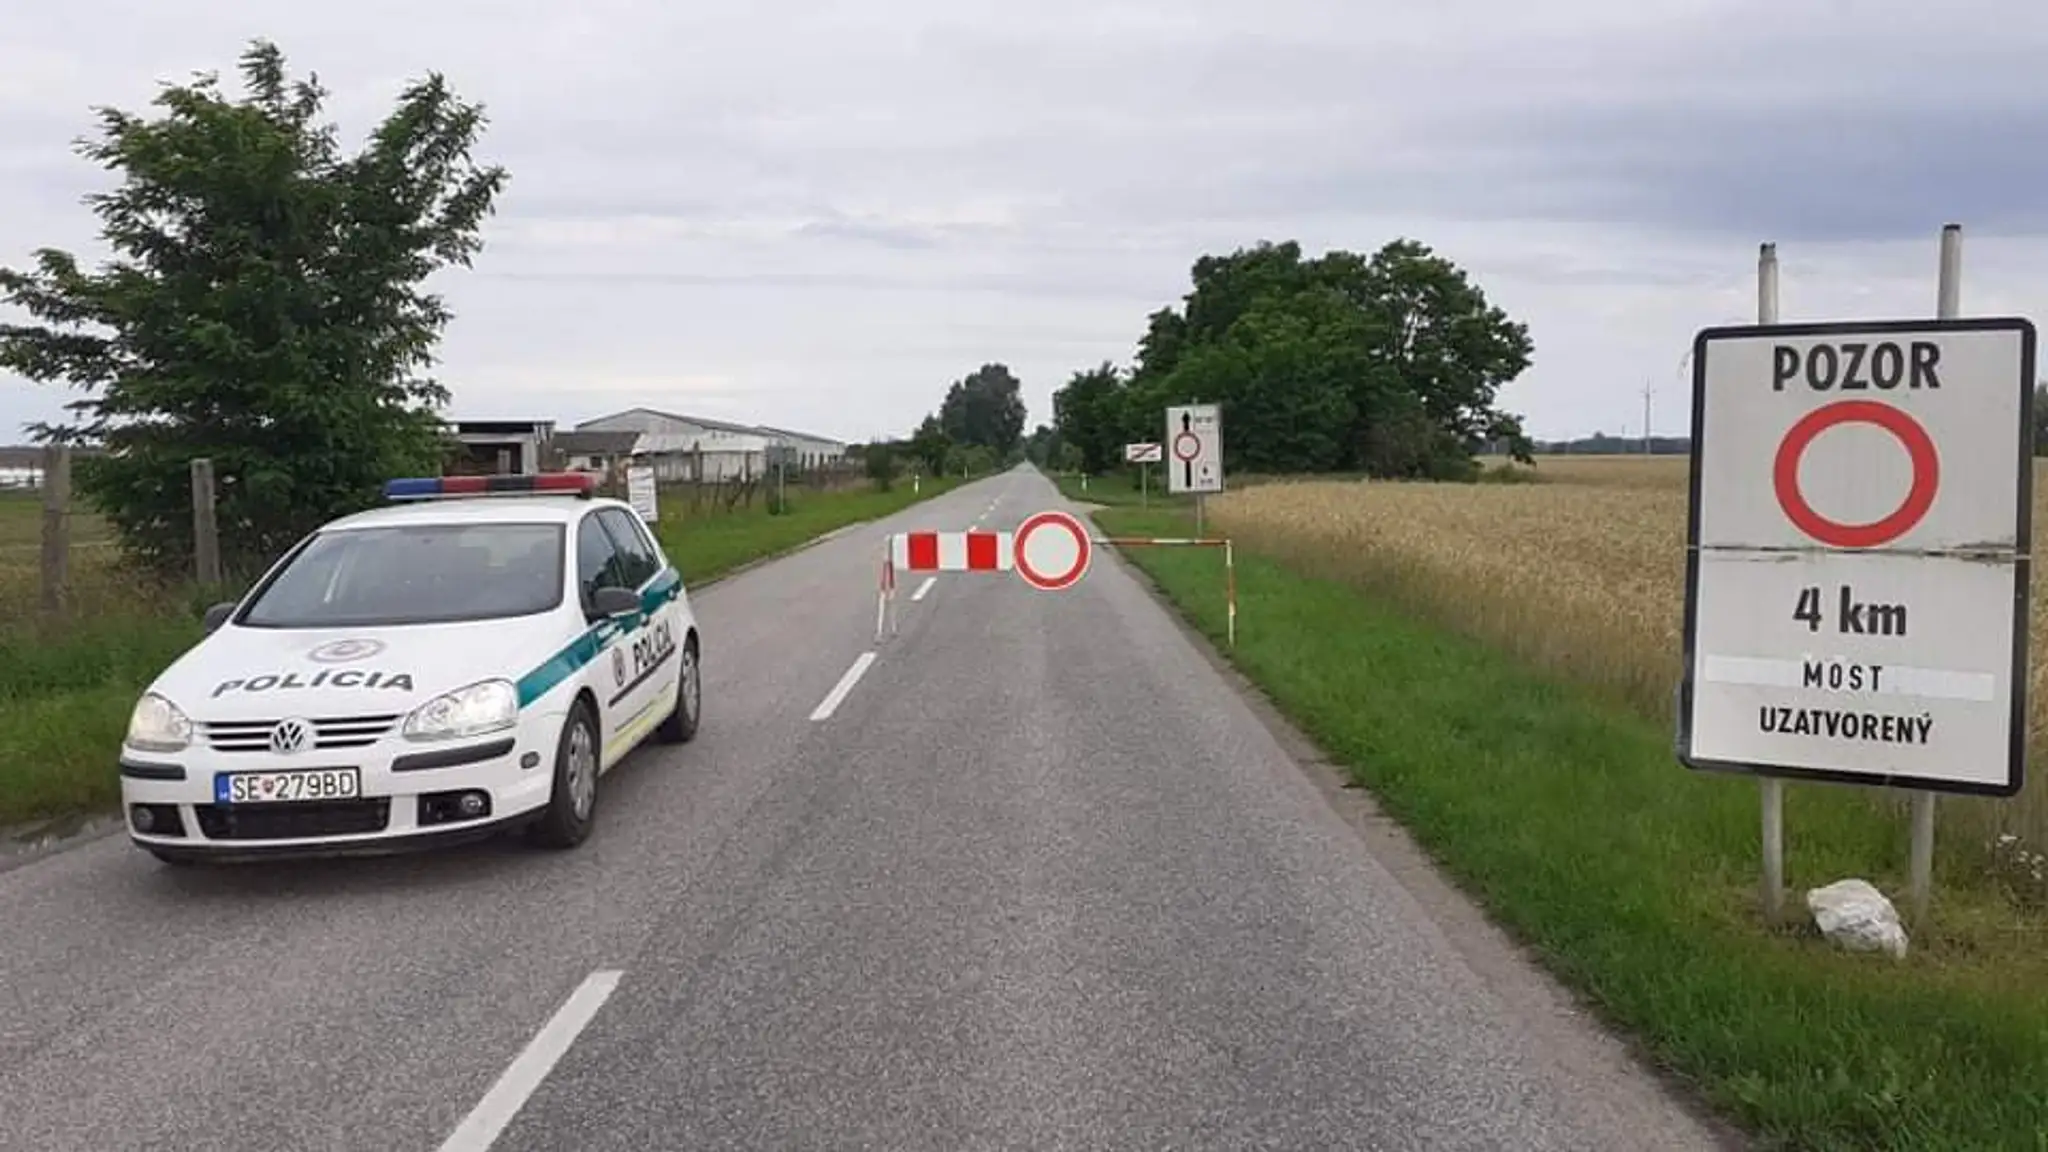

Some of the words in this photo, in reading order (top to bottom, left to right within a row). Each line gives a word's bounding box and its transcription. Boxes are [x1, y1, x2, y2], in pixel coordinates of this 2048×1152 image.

[1773, 341, 1941, 392] POZOR
[1793, 586, 1822, 632] 4
[1839, 585, 1907, 636] km
[1803, 660, 1883, 692] MOST
[1760, 705, 1934, 744] UZATVORENÝ
